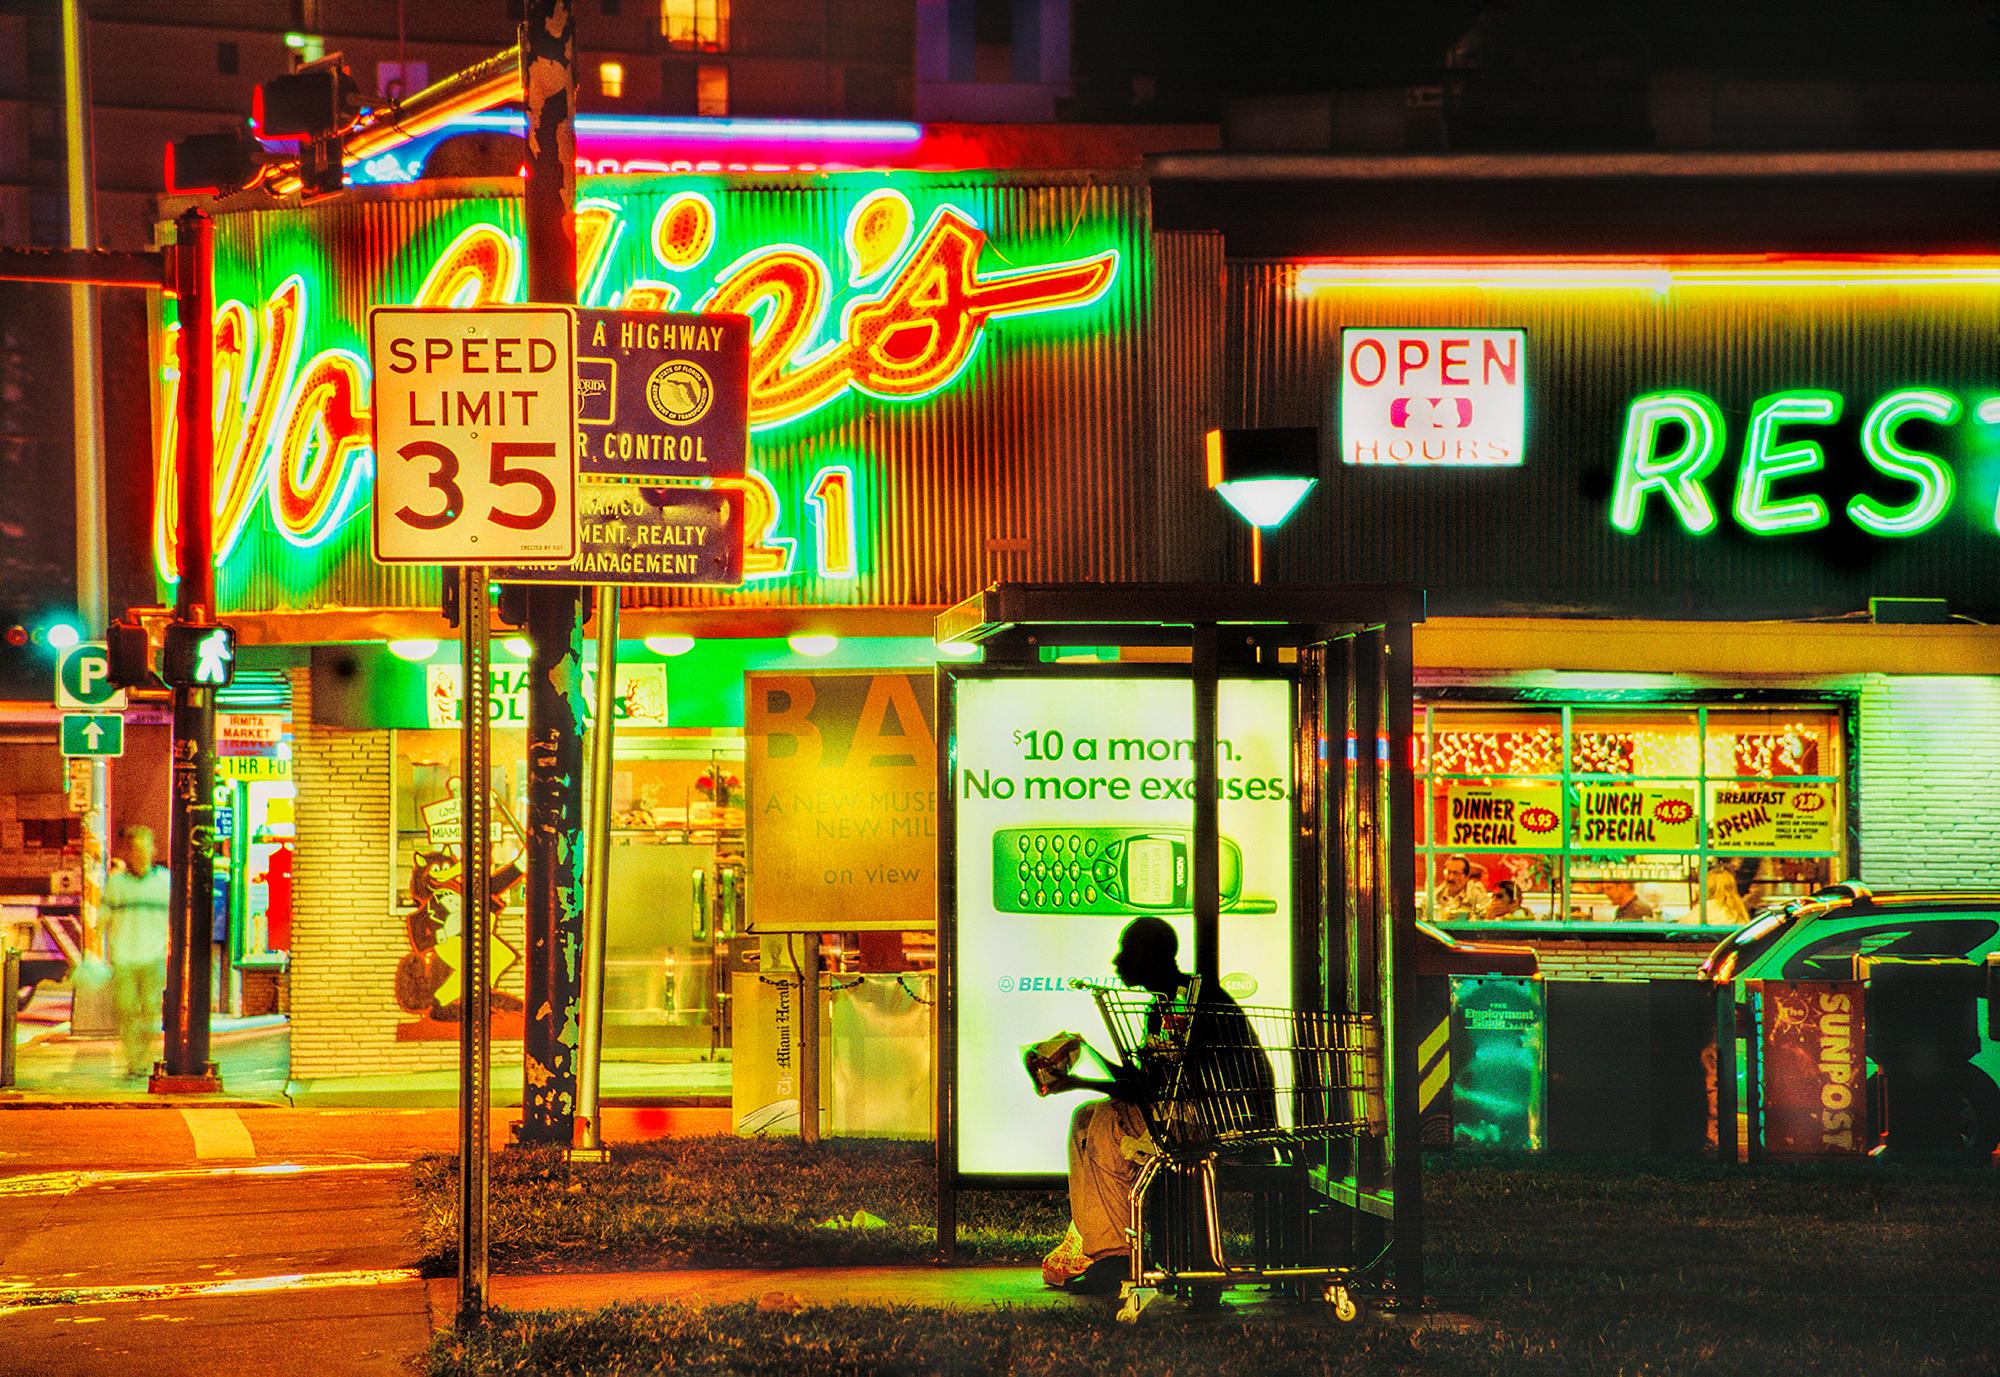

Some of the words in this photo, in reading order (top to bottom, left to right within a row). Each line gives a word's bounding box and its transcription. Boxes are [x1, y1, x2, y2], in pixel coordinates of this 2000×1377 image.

[591, 321, 606, 347] A
[621, 321, 724, 351] HIGHWAY
[389, 338, 557, 374] SPEED
[1349, 337, 1517, 388] OPEN
[408, 390, 539, 427] LIMIT
[603, 432, 708, 462] CONTROL
[1355, 439, 1510, 463] HOURS
[394, 440, 557, 530] 35
[637, 525, 707, 546] REALTY
[570, 552, 700, 574] MANAGEMENT
[79, 656, 108, 694] P
[223, 728, 270, 739] MARKET
[1072, 738, 1098, 761] a
[962, 768, 1016, 800] No
[1023, 776, 1131, 800] more
[1453, 797, 1515, 822] DINNER
[1585, 792, 1644, 817] LUNCH
[1716, 791, 1786, 805] BREAKFAST
[1523, 813, 1553, 828] $6.95
[1656, 804, 1688, 819] $4.95
[1716, 805, 1772, 840] SPECIAL
[1452, 822, 1517, 845] SPECIAL
[1584, 818, 1657, 842] SPECIAL
[823, 868, 853, 885] on
[865, 863, 921, 885] view
[1224, 979, 1254, 991] SEND
[1465, 1008, 1534, 1021] Employment
[776, 1025, 791, 1069] Miami
[1818, 991, 1853, 1150] SUNPOST
